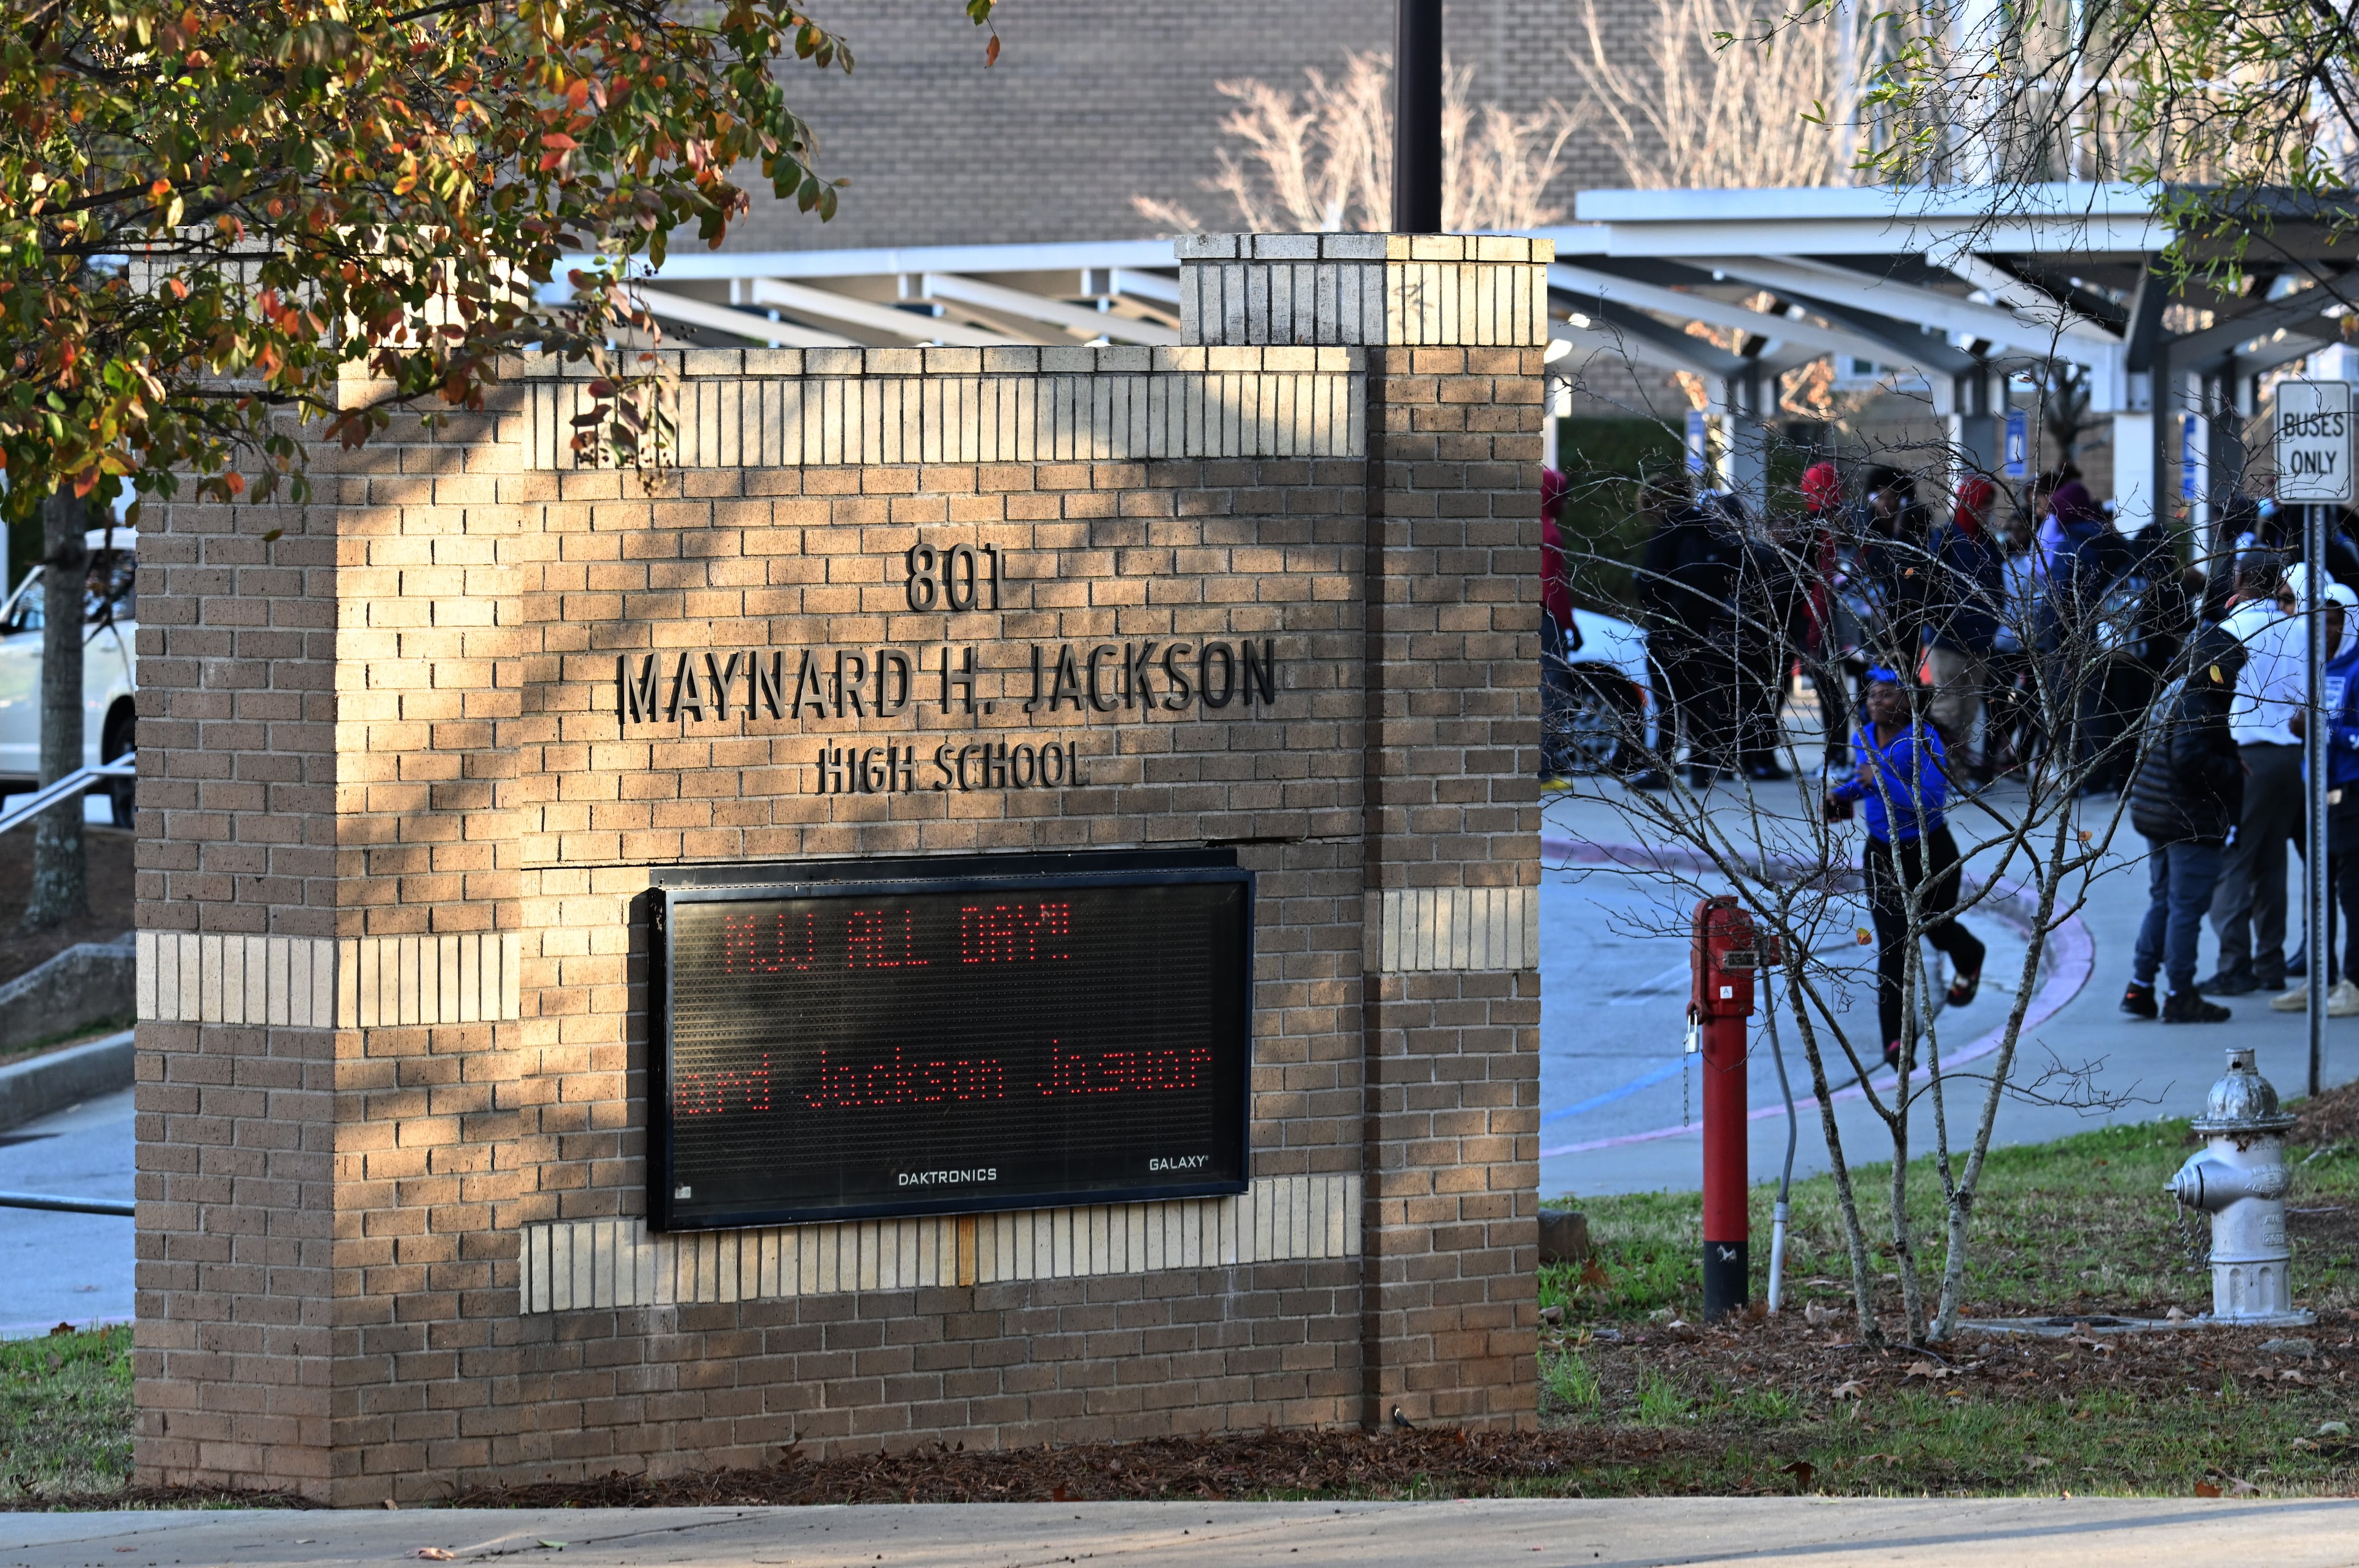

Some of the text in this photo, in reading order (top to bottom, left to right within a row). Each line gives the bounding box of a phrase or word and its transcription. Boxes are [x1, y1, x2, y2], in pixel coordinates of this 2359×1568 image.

[2283, 412, 2344, 437] BUSES
[2291, 450, 2336, 474] ONLY
[910, 542, 1003, 611] 801
[617, 639, 1275, 724] MAYNARD H. JACKSON
[820, 741, 1089, 793] HIGH SCHOOL
[848, 909, 928, 968] ALL
[673, 1039, 1212, 1115] ard Jackson Jaguar
[899, 1168, 996, 1186] DAKTRONICS
